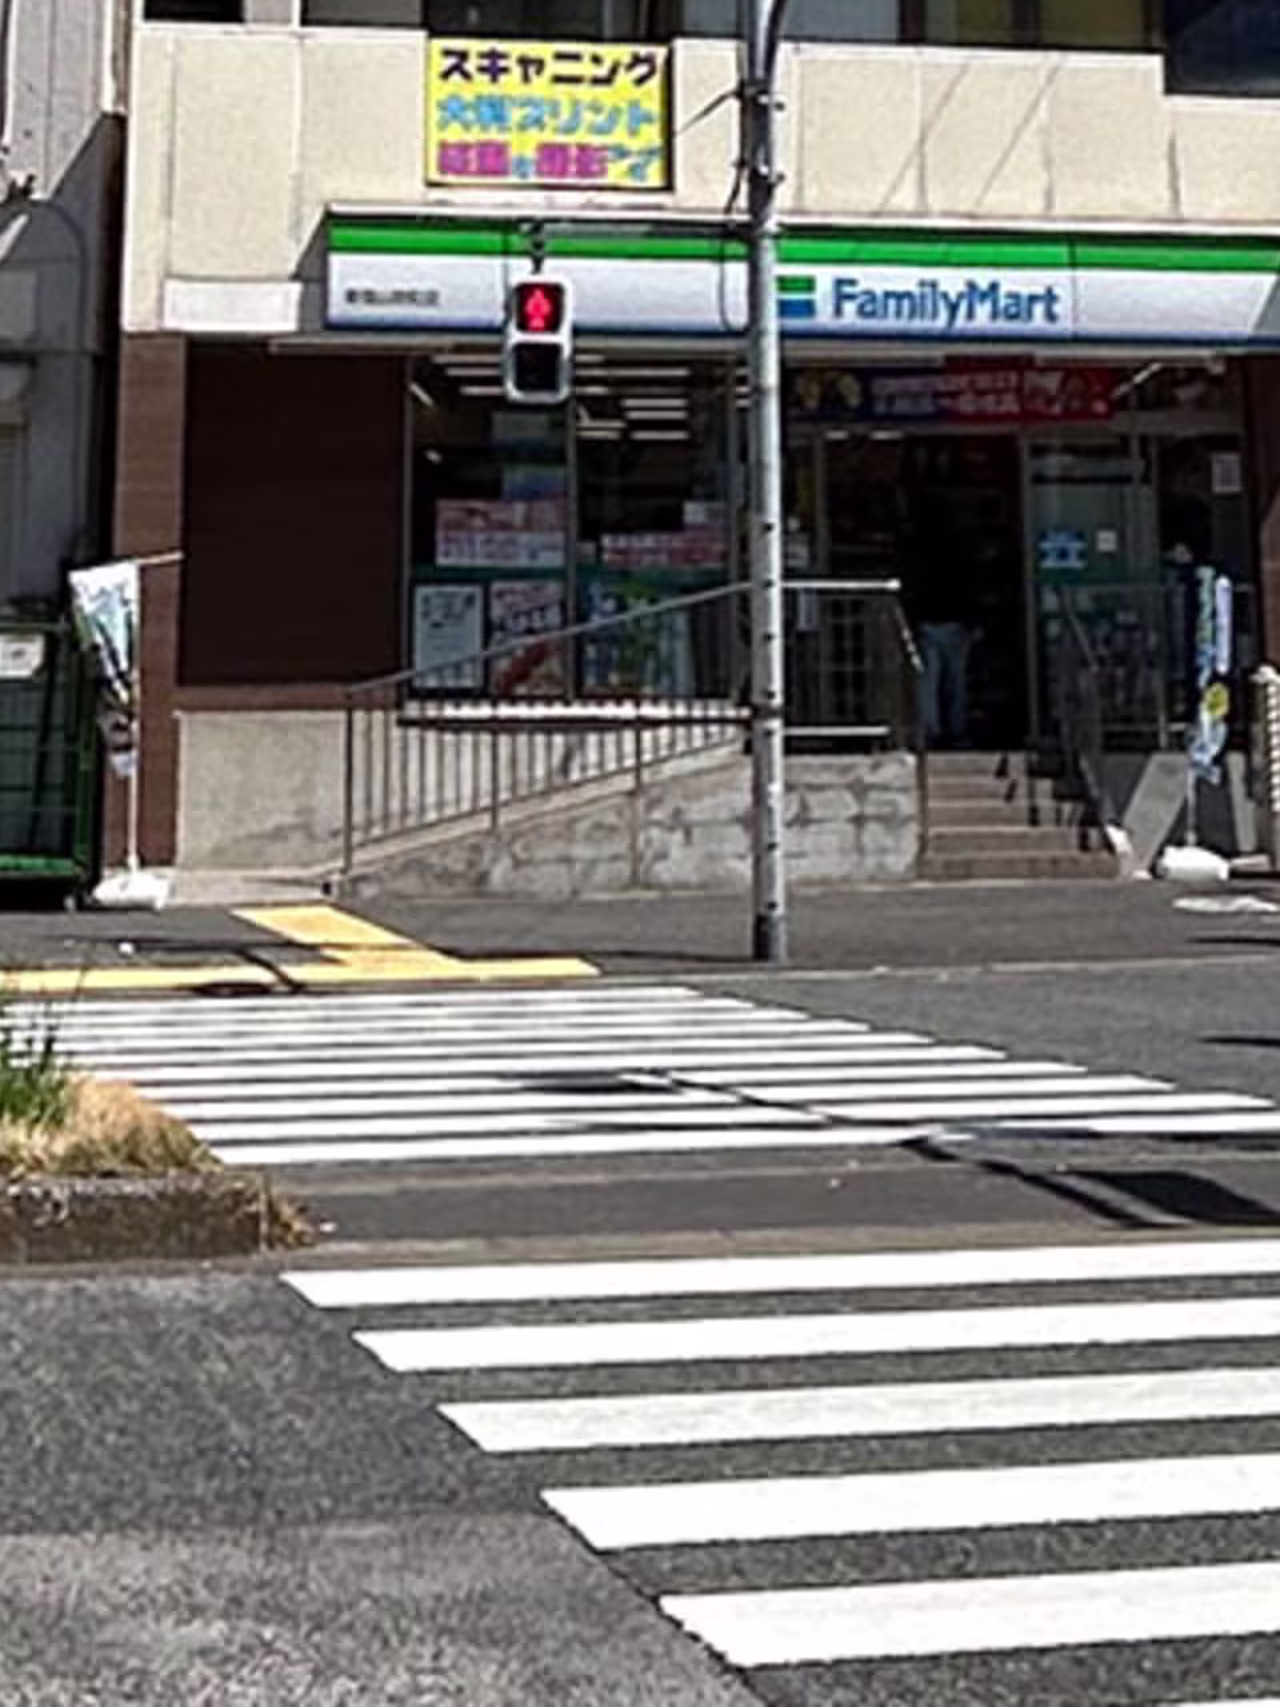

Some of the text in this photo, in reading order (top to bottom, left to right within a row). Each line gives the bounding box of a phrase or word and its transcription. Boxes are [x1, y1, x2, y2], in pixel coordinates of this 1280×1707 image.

[439, 48, 657, 86] スキャニング
[833, 278, 1060, 330] FamilyMart
